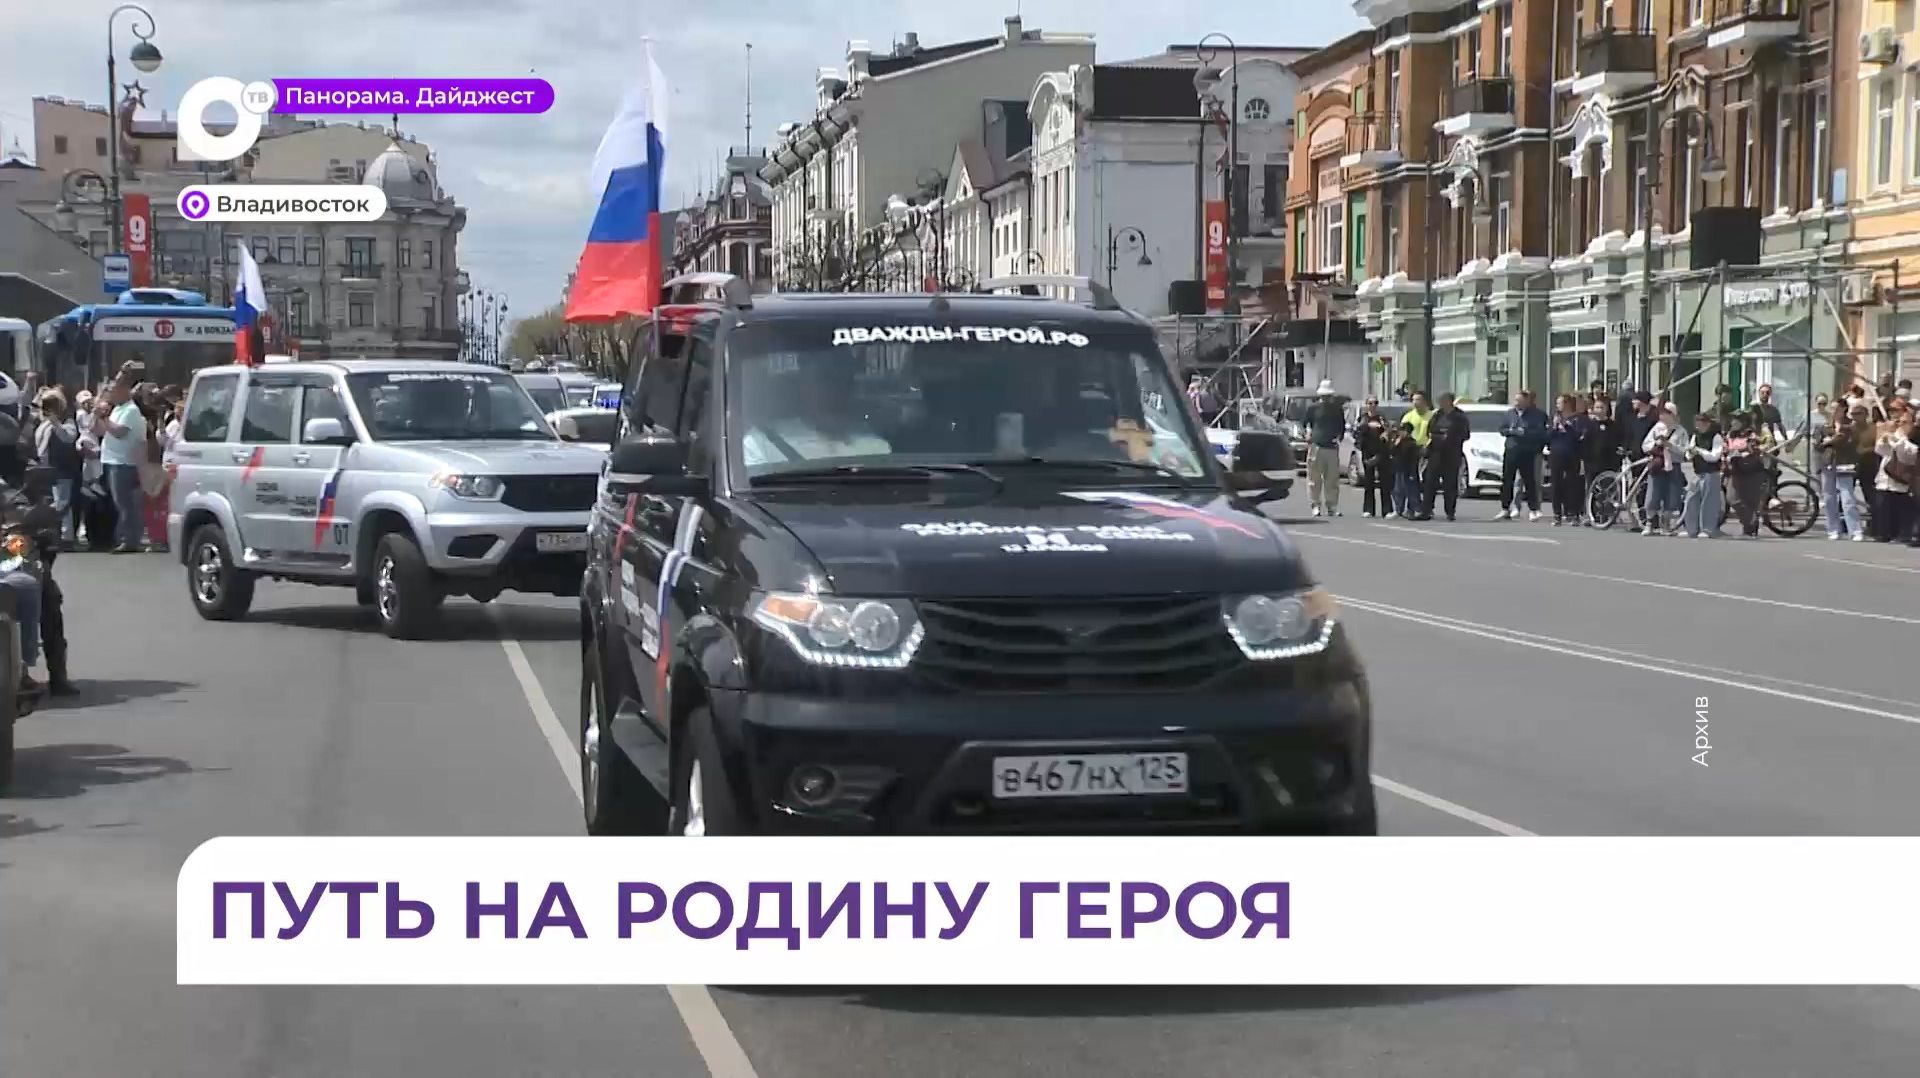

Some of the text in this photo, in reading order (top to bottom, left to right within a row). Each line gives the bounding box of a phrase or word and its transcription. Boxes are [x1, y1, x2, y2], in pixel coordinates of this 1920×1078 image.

[128, 215, 147, 243] 9
[1209, 220, 1223, 246] 9
[833, 325, 1090, 347] ДВАЖДЫ-ГЕРОЙ.РФ
[333, 523, 349, 545] 07
[1003, 755, 1184, 793] В467НХ 125
